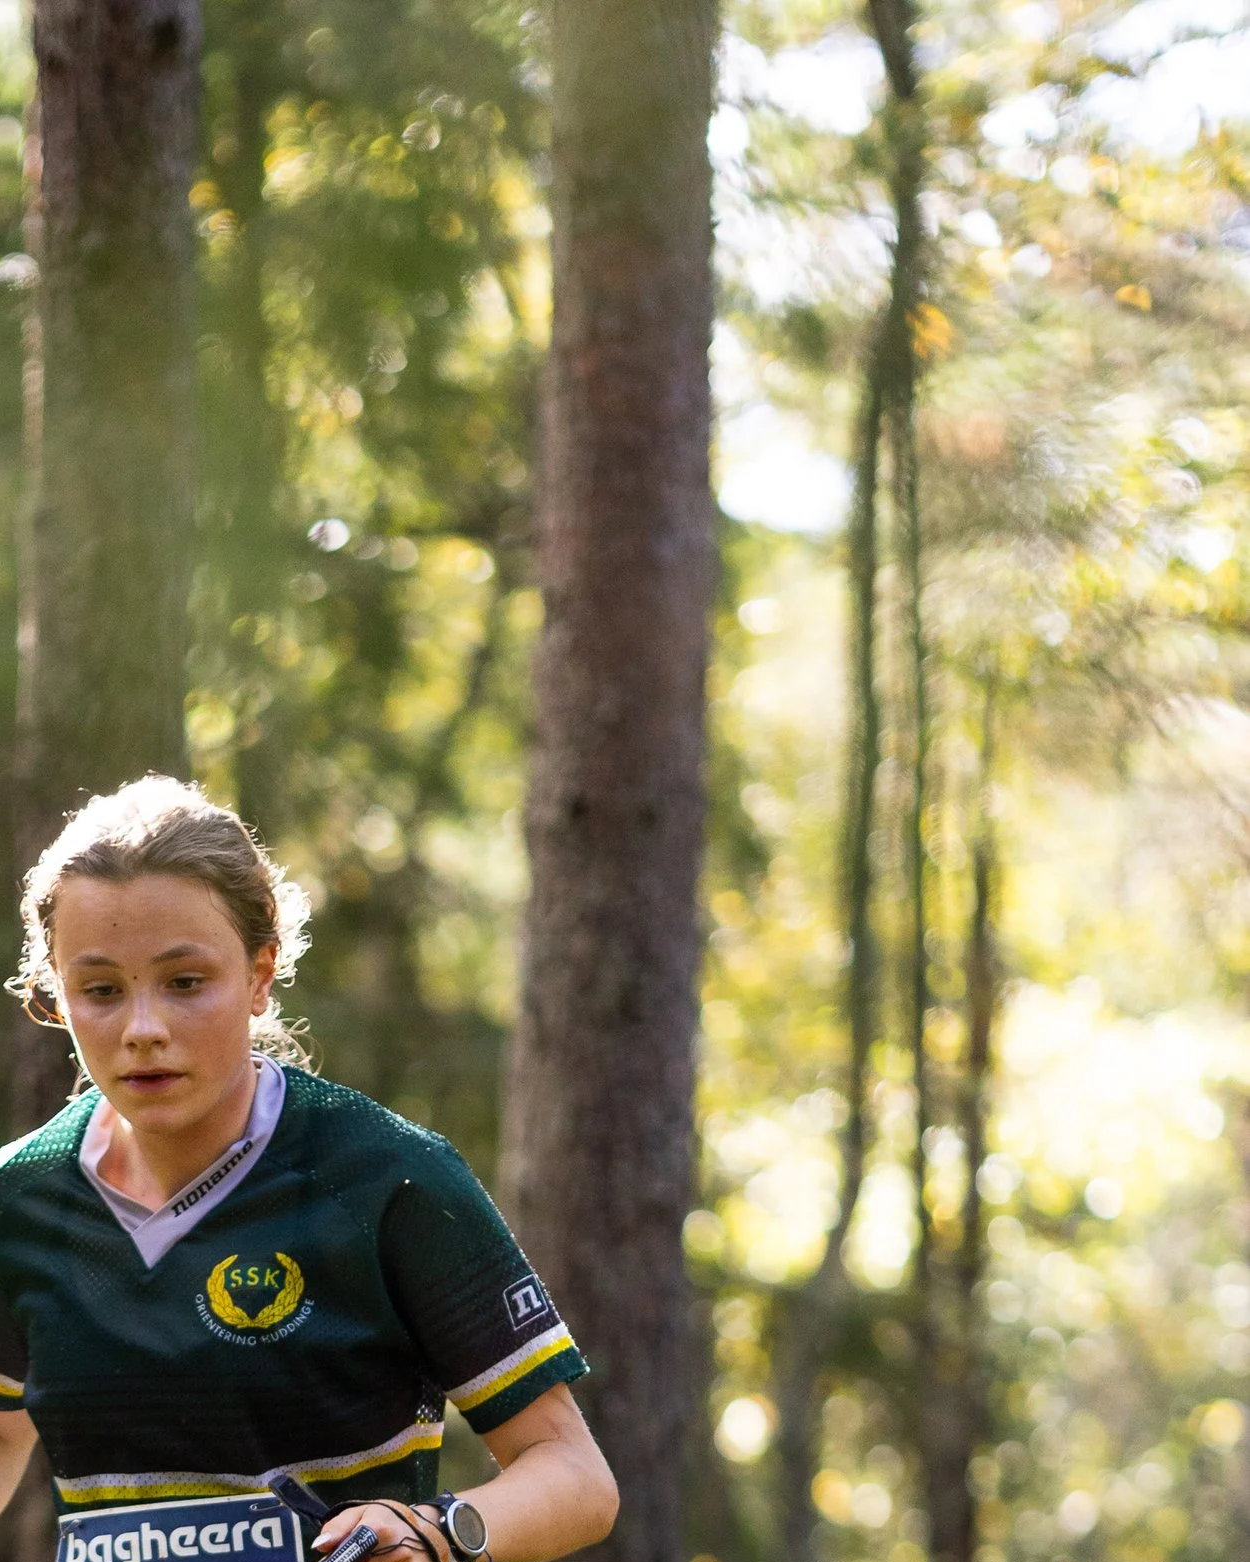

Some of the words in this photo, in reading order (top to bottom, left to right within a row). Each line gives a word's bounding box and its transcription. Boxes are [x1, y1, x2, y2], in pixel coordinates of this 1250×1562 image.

[170, 1140, 254, 1217] noname
[229, 1266, 280, 1288] SSK
[195, 1293, 257, 1346] ORIENTERING
